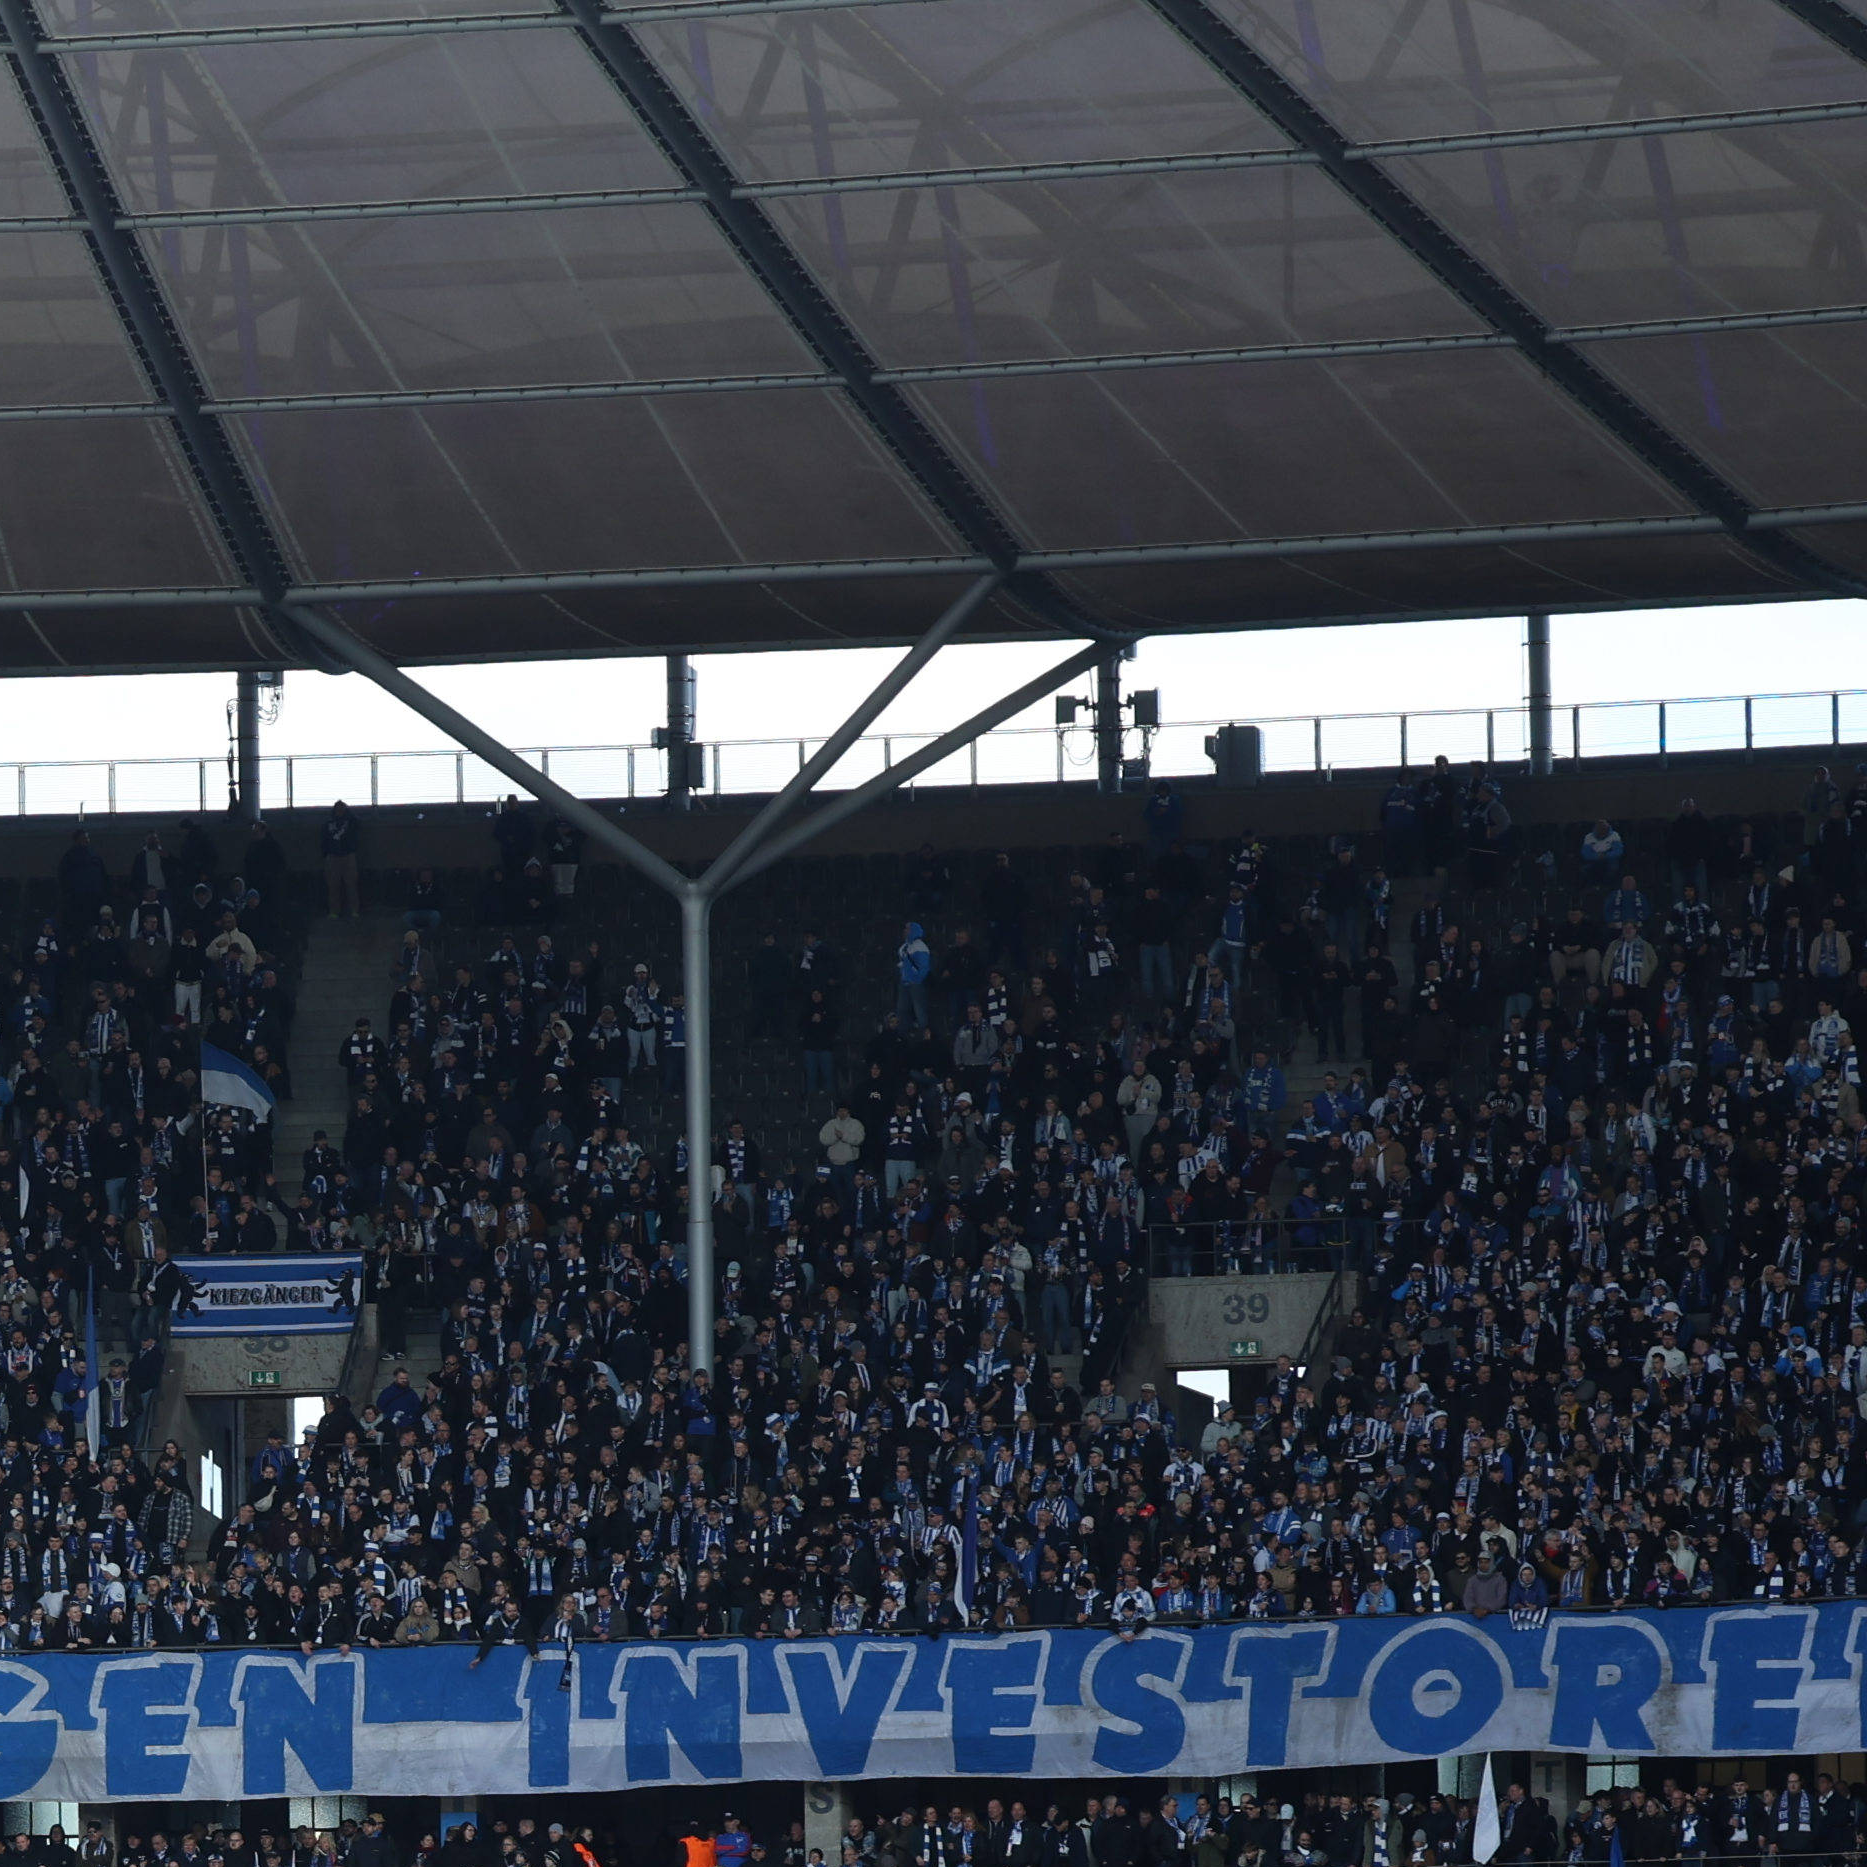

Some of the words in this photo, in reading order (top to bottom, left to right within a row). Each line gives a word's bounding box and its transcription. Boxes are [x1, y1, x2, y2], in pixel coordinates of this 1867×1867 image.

[208, 1282, 325, 1306] KIEZGÄNGER
[1222, 1292, 1271, 1326] 39
[518, 1606, 1867, 1788] INVESTORE
[1535, 1759, 1562, 1793] T
[808, 1783, 835, 1814] S
